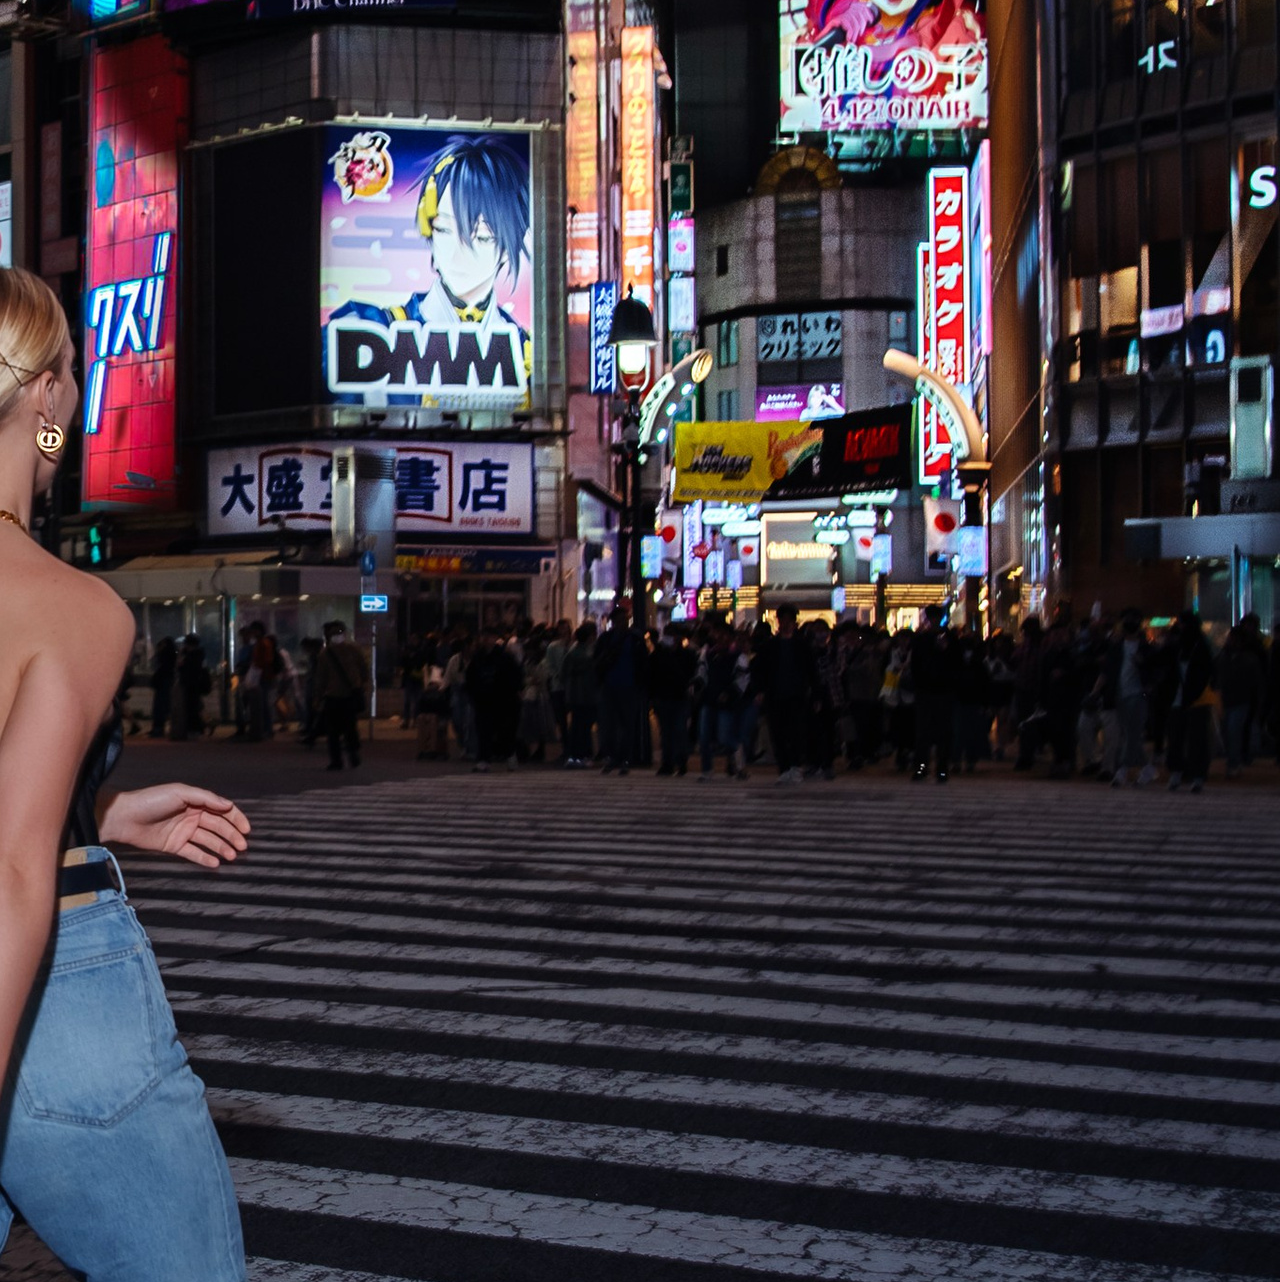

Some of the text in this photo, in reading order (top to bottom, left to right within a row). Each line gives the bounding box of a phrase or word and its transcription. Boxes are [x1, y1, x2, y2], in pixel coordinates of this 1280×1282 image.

[934, 189, 963, 328] カラオケ
[761, 338, 840, 360] クリニック
[782, 316, 841, 335] れいわ
[337, 329, 521, 388] DMM
[220, 457, 510, 516] 大盛書店
